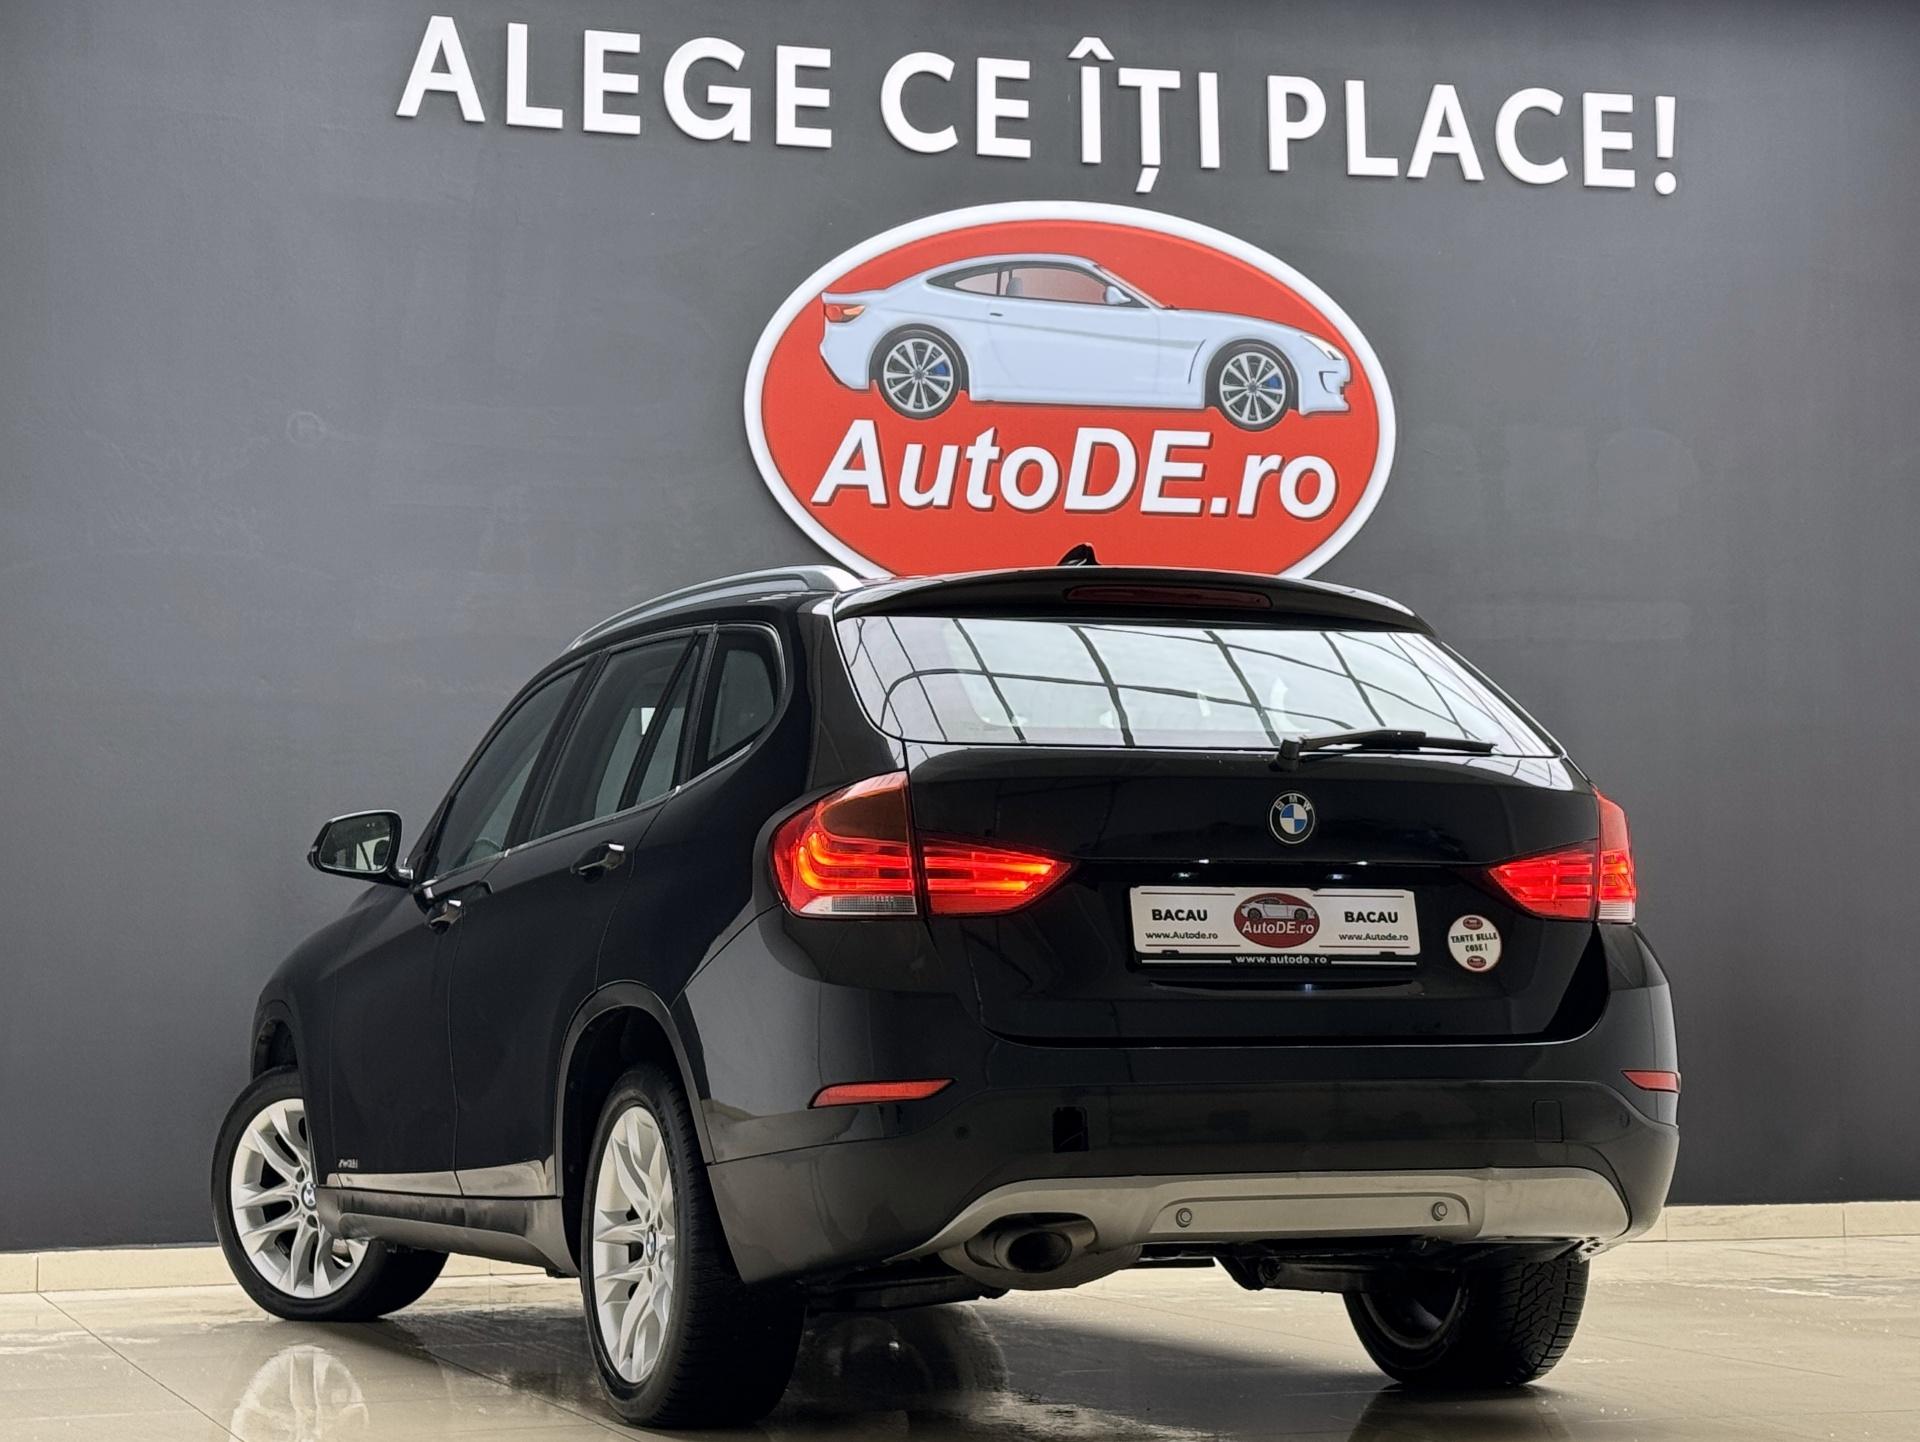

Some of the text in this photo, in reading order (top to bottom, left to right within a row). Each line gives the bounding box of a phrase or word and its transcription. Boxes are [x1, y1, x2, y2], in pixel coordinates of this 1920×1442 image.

[396, 15, 832, 148] ALEGE
[880, 51, 1031, 159] CE
[1267, 74, 1677, 195] PLACE!
[811, 419, 1337, 519] AutoDE.ro
[1274, 794, 1312, 811] BMW
[1151, 909, 1208, 921] BACAU
[1343, 911, 1398, 923] BACAU
[1242, 921, 1315, 934] AutoDE.ro
[1145, 931, 1218, 940] www.Autode.ro
[1338, 933, 1409, 941] www.Autode.ro
[1235, 956, 1327, 964] www.autode.ro
